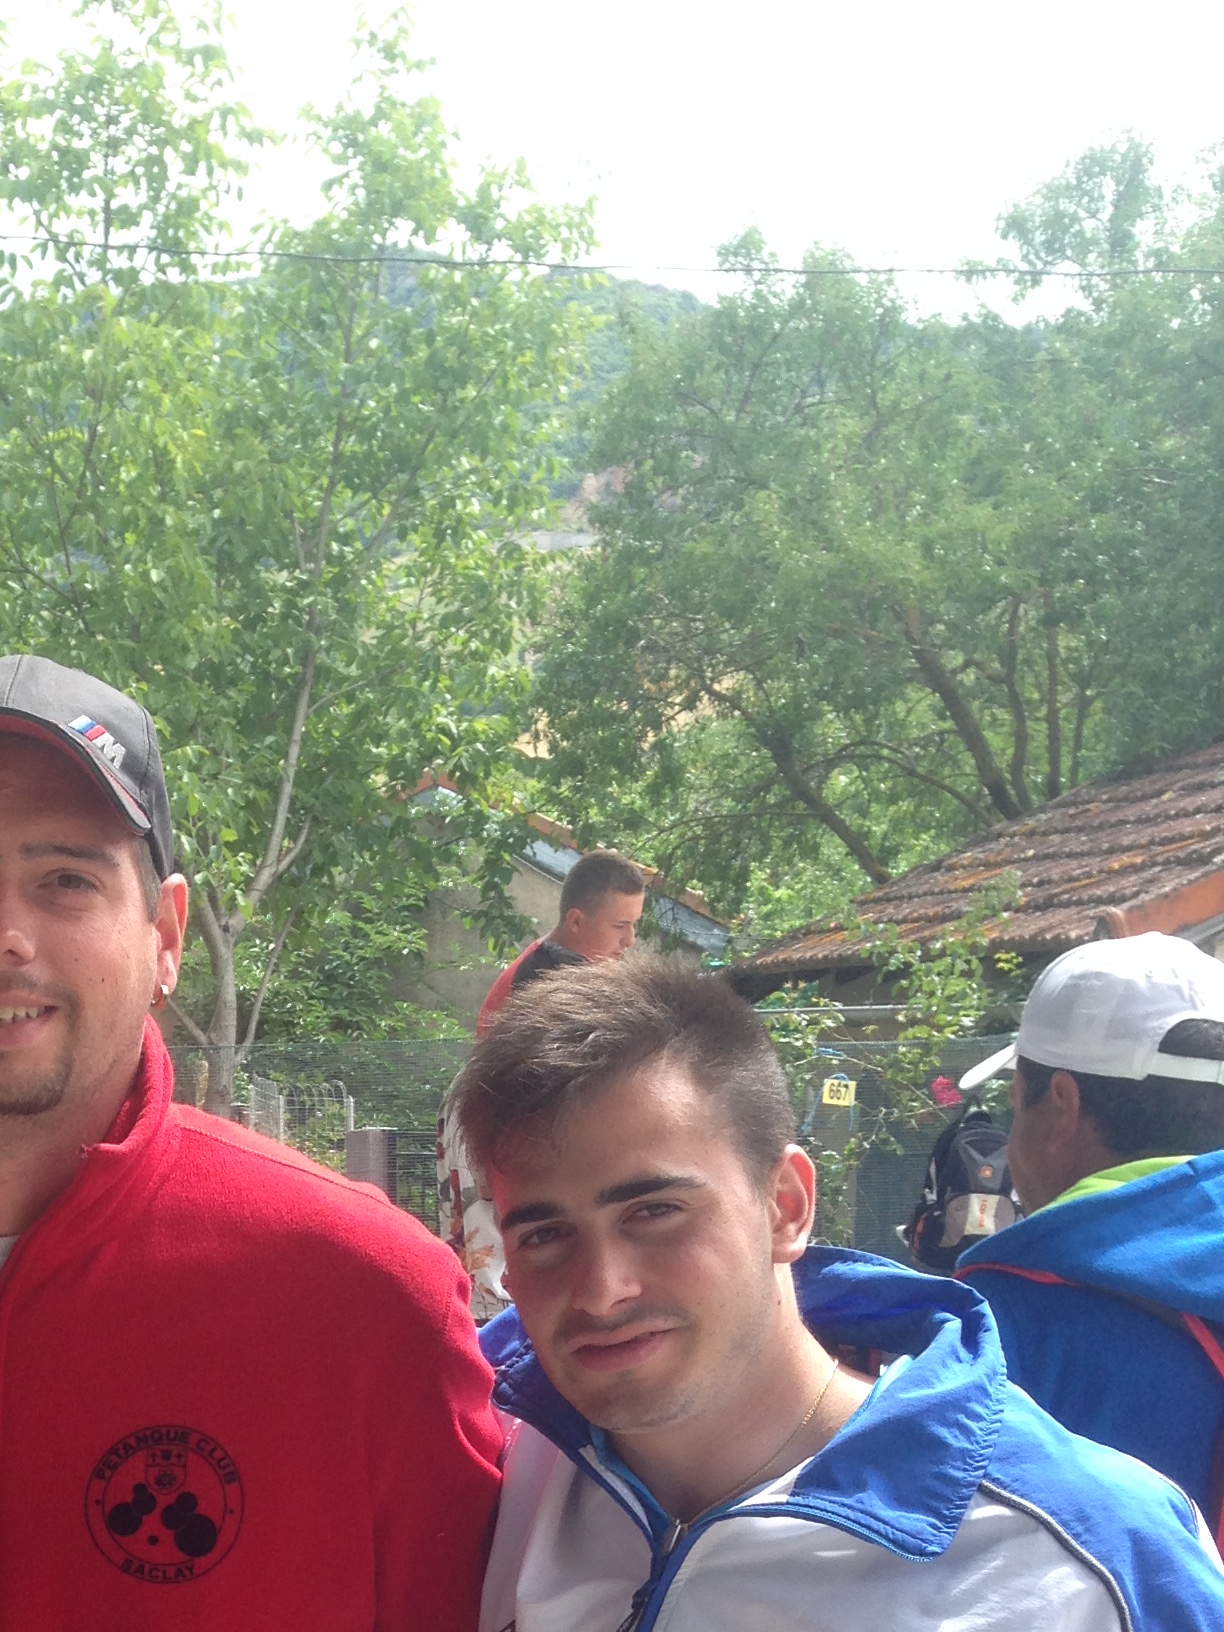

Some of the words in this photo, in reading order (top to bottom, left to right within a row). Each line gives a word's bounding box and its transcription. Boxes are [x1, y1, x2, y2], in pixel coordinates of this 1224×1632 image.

[829, 1082, 849, 1101] 667
[196, 1438, 238, 1484] CLUB
[121, 1558, 196, 1582] SACLAY
